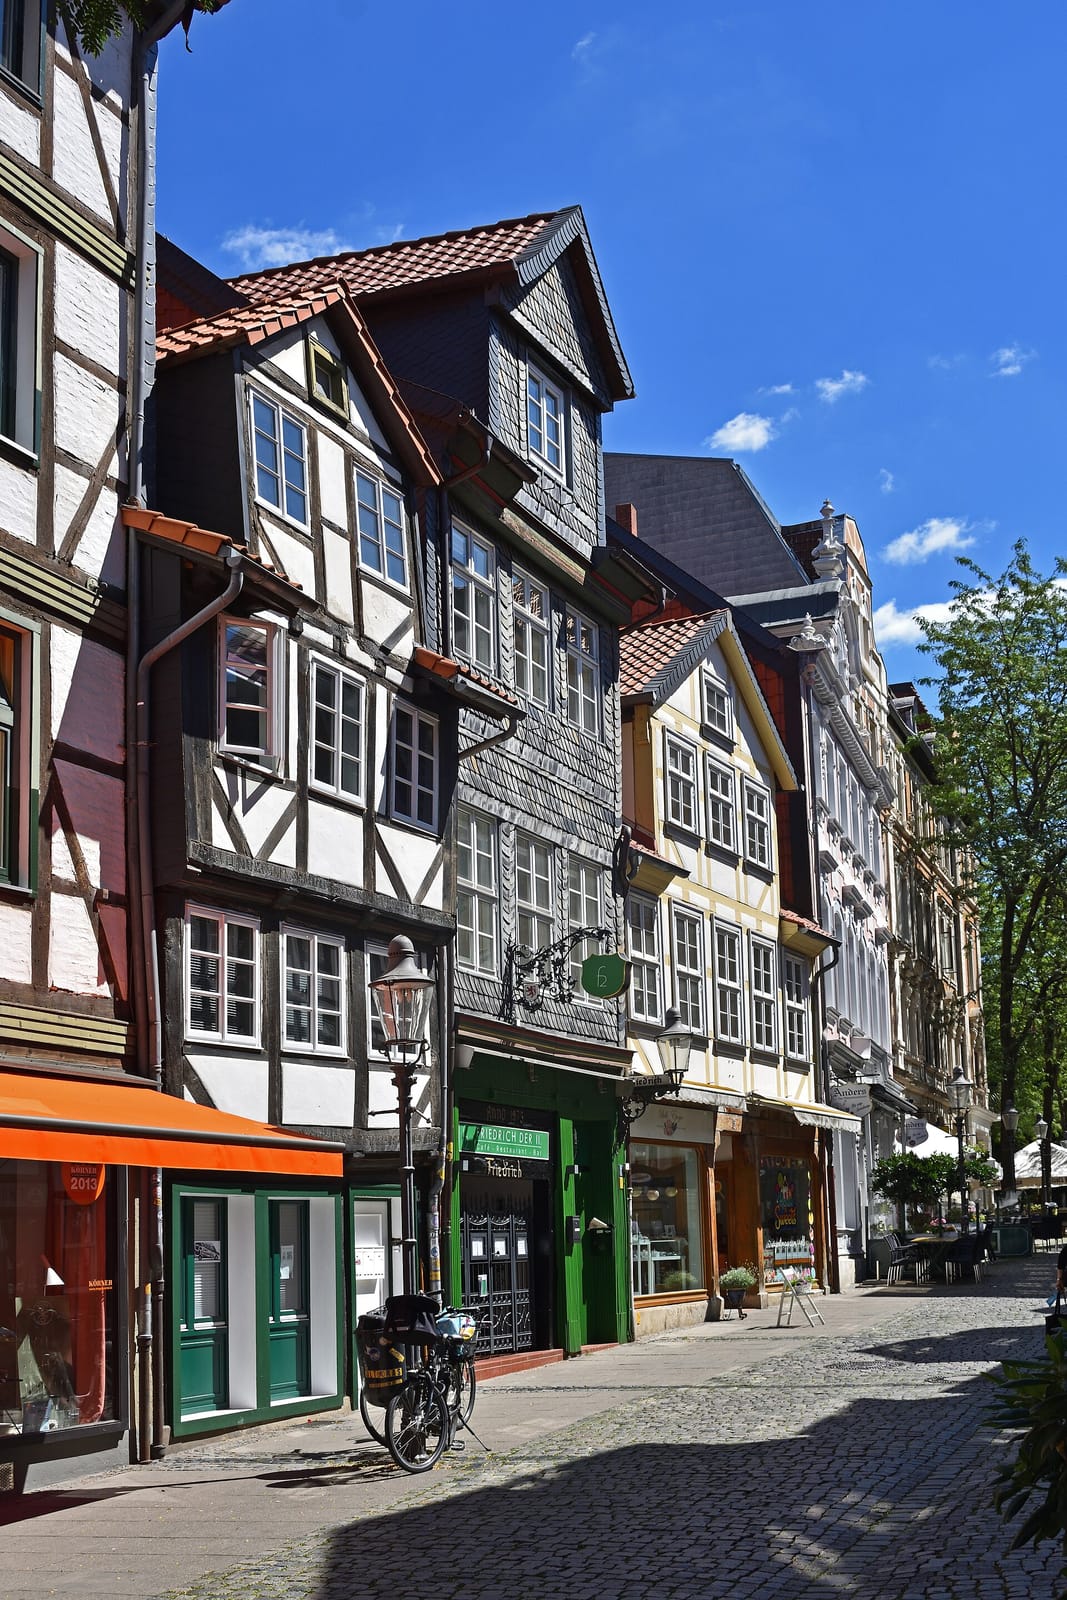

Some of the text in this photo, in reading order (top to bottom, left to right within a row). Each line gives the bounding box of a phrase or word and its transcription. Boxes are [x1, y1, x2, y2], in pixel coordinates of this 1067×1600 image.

[833, 1087, 867, 1097] Anders
[519, 1132, 532, 1145] DER
[70, 1177, 97, 1190] 2013
